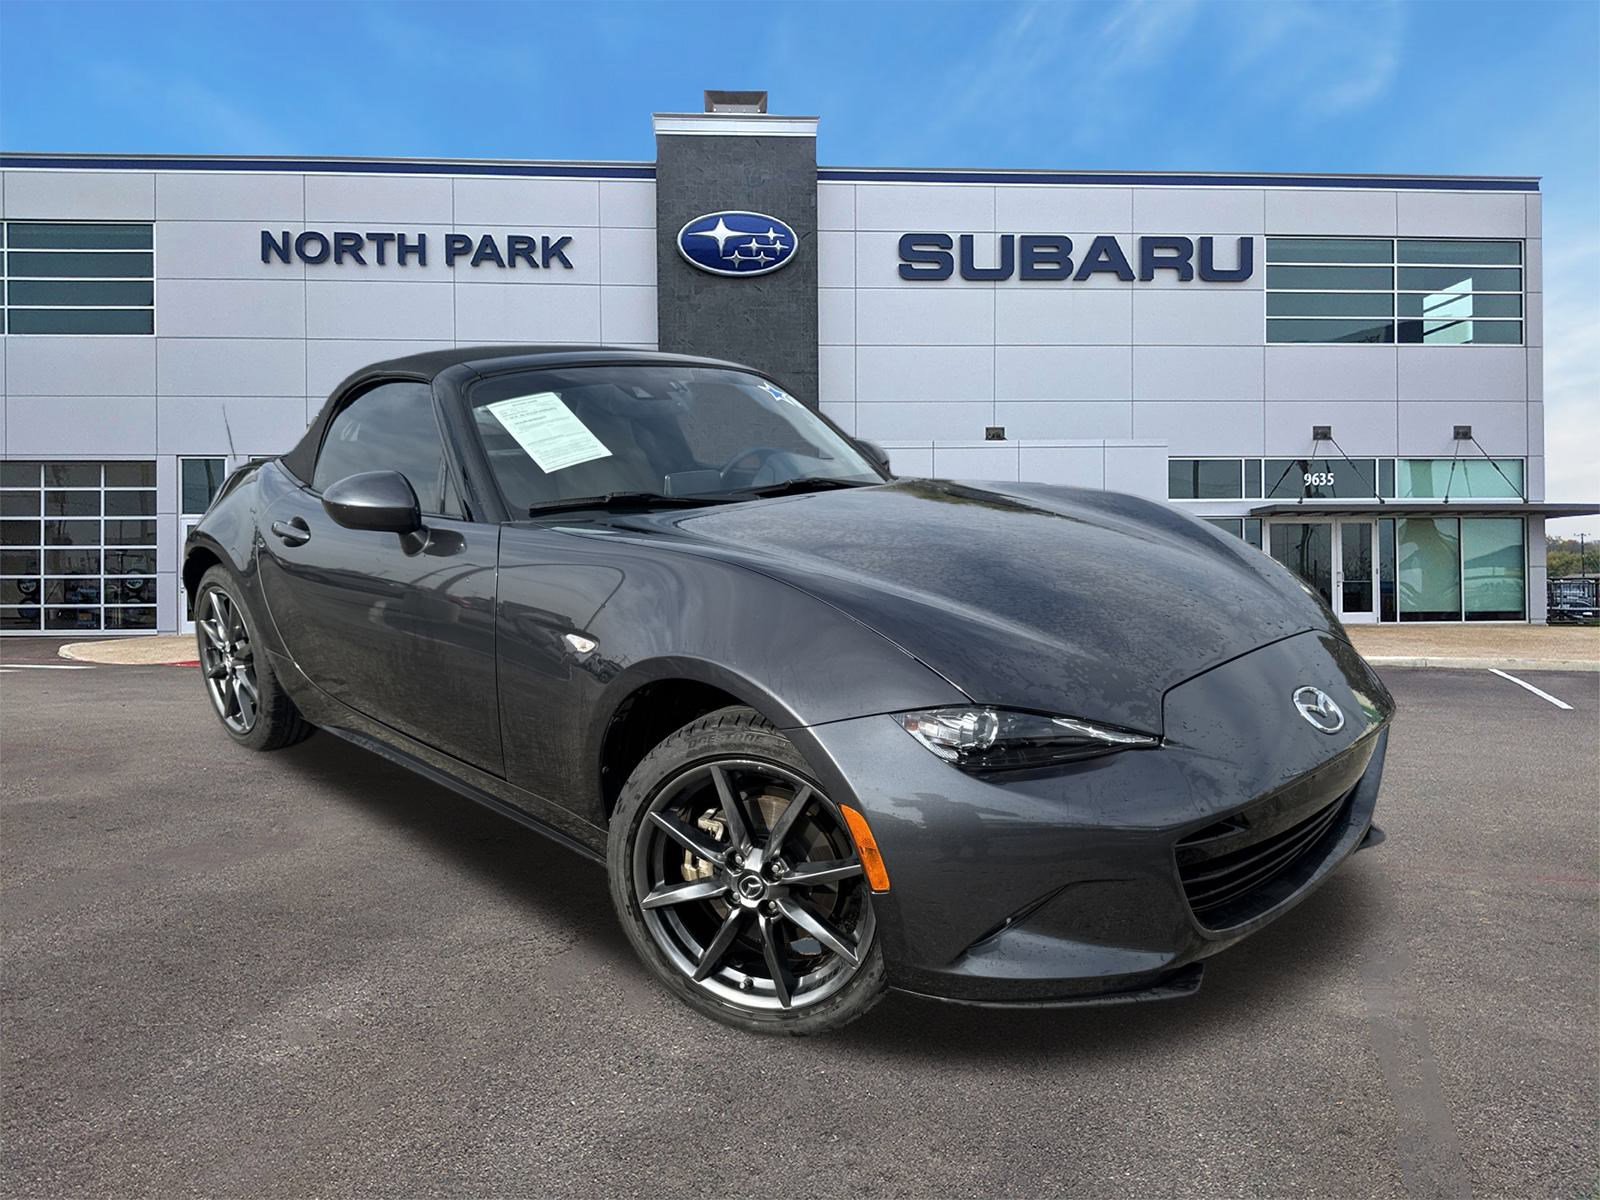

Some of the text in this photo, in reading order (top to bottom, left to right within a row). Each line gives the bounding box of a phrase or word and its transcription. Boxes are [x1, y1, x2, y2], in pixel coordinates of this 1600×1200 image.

[260, 230, 573, 269] NORTH PARK
[898, 233, 1254, 283] SUBARU
[1303, 472, 1335, 487] 9635
